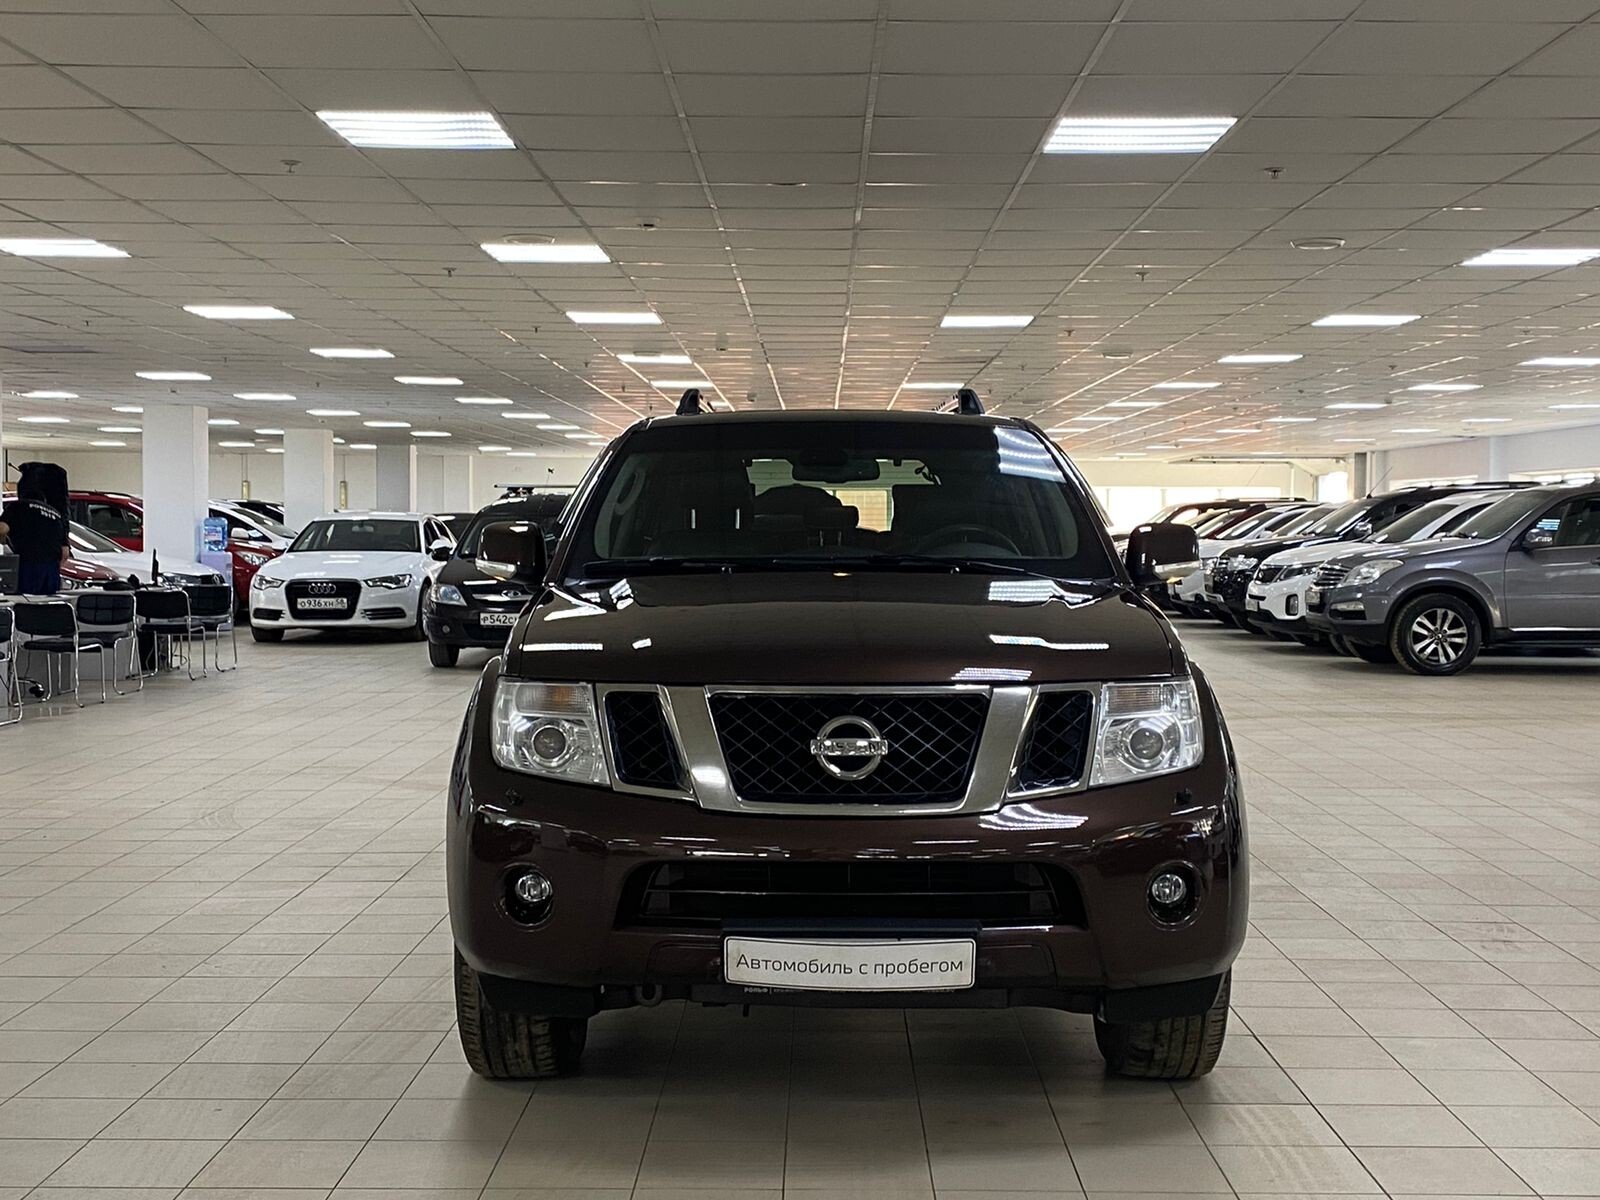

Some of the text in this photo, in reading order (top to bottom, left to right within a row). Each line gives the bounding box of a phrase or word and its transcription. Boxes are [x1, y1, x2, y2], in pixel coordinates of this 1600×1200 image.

[736, 953, 963, 977] Автомобиль с пробегом
